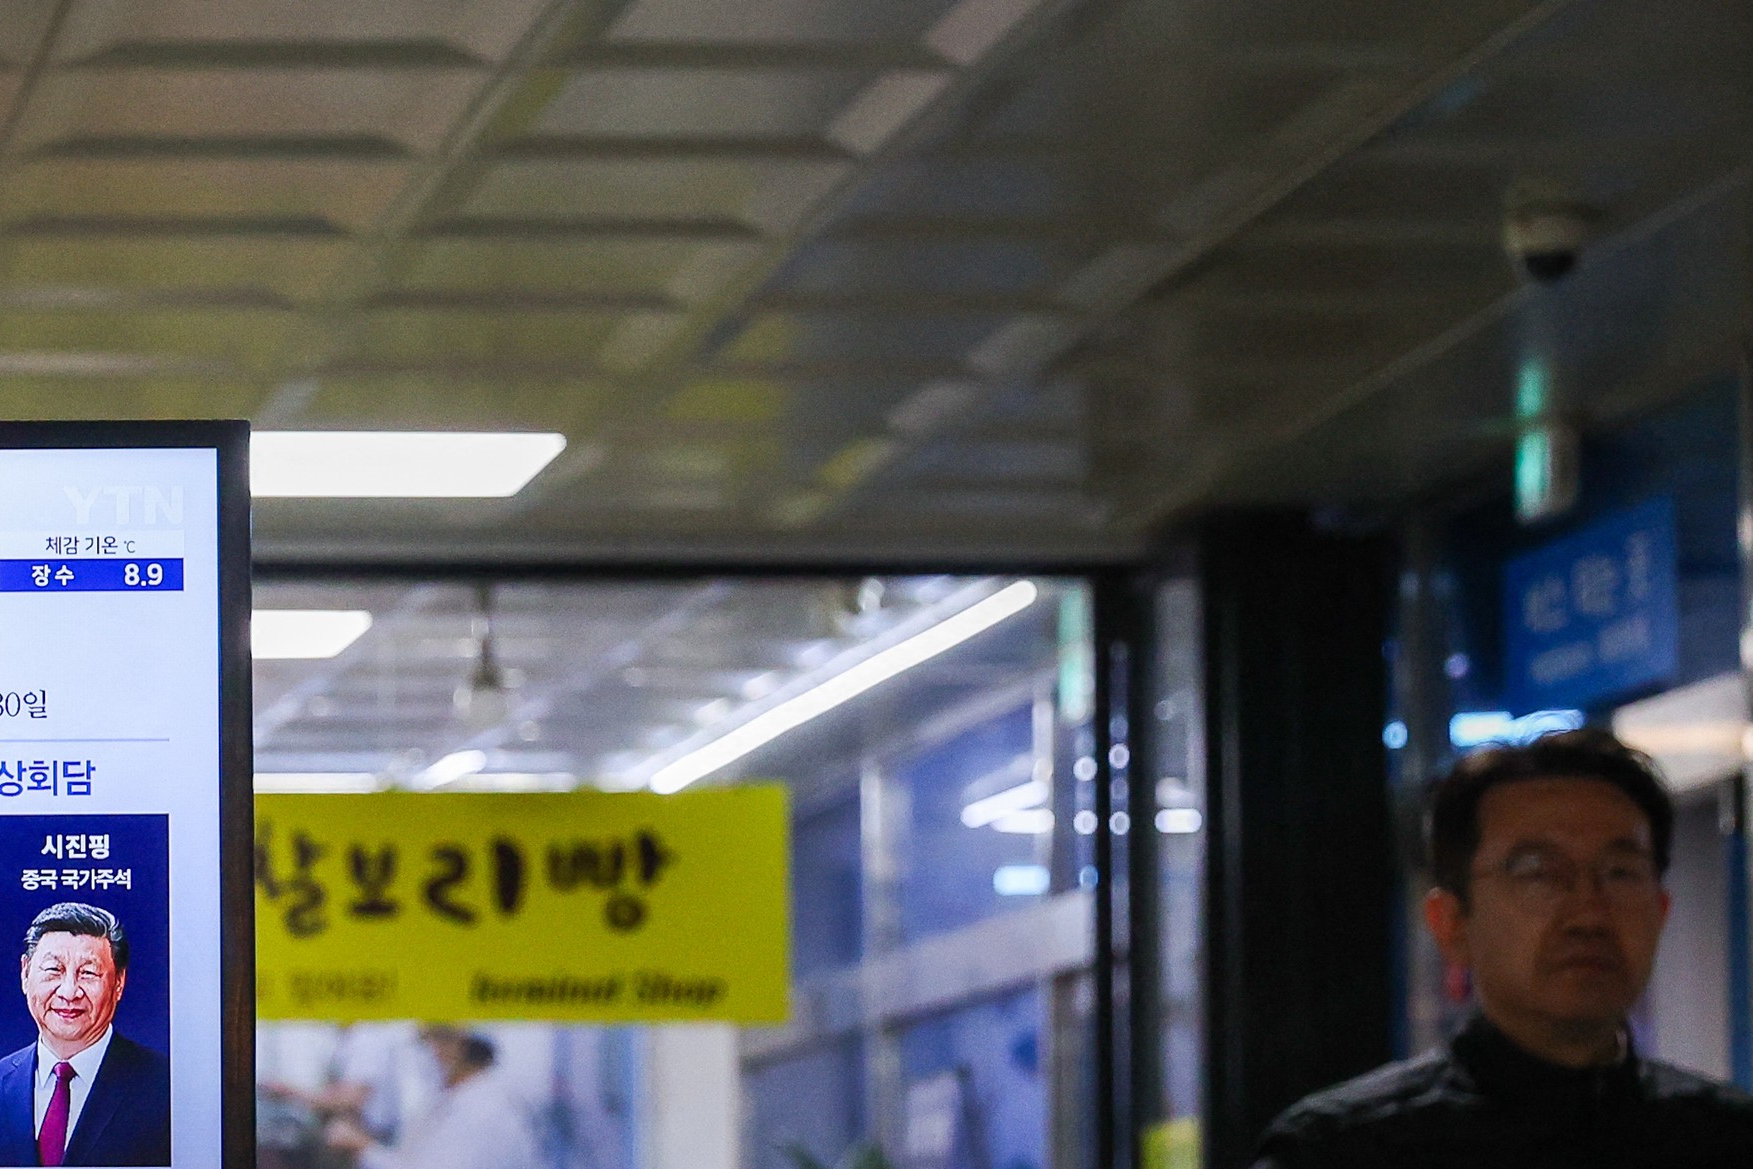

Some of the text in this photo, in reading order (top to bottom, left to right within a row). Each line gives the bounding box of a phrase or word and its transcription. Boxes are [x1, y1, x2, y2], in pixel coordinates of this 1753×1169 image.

[62, 484, 185, 525] YTN
[45, 536, 80, 555] 체감
[85, 536, 118, 555] 기온
[124, 563, 163, 587] 8.9
[40, 833, 110, 860] 시진핑
[20, 868, 132, 891] 중국 국가주석
